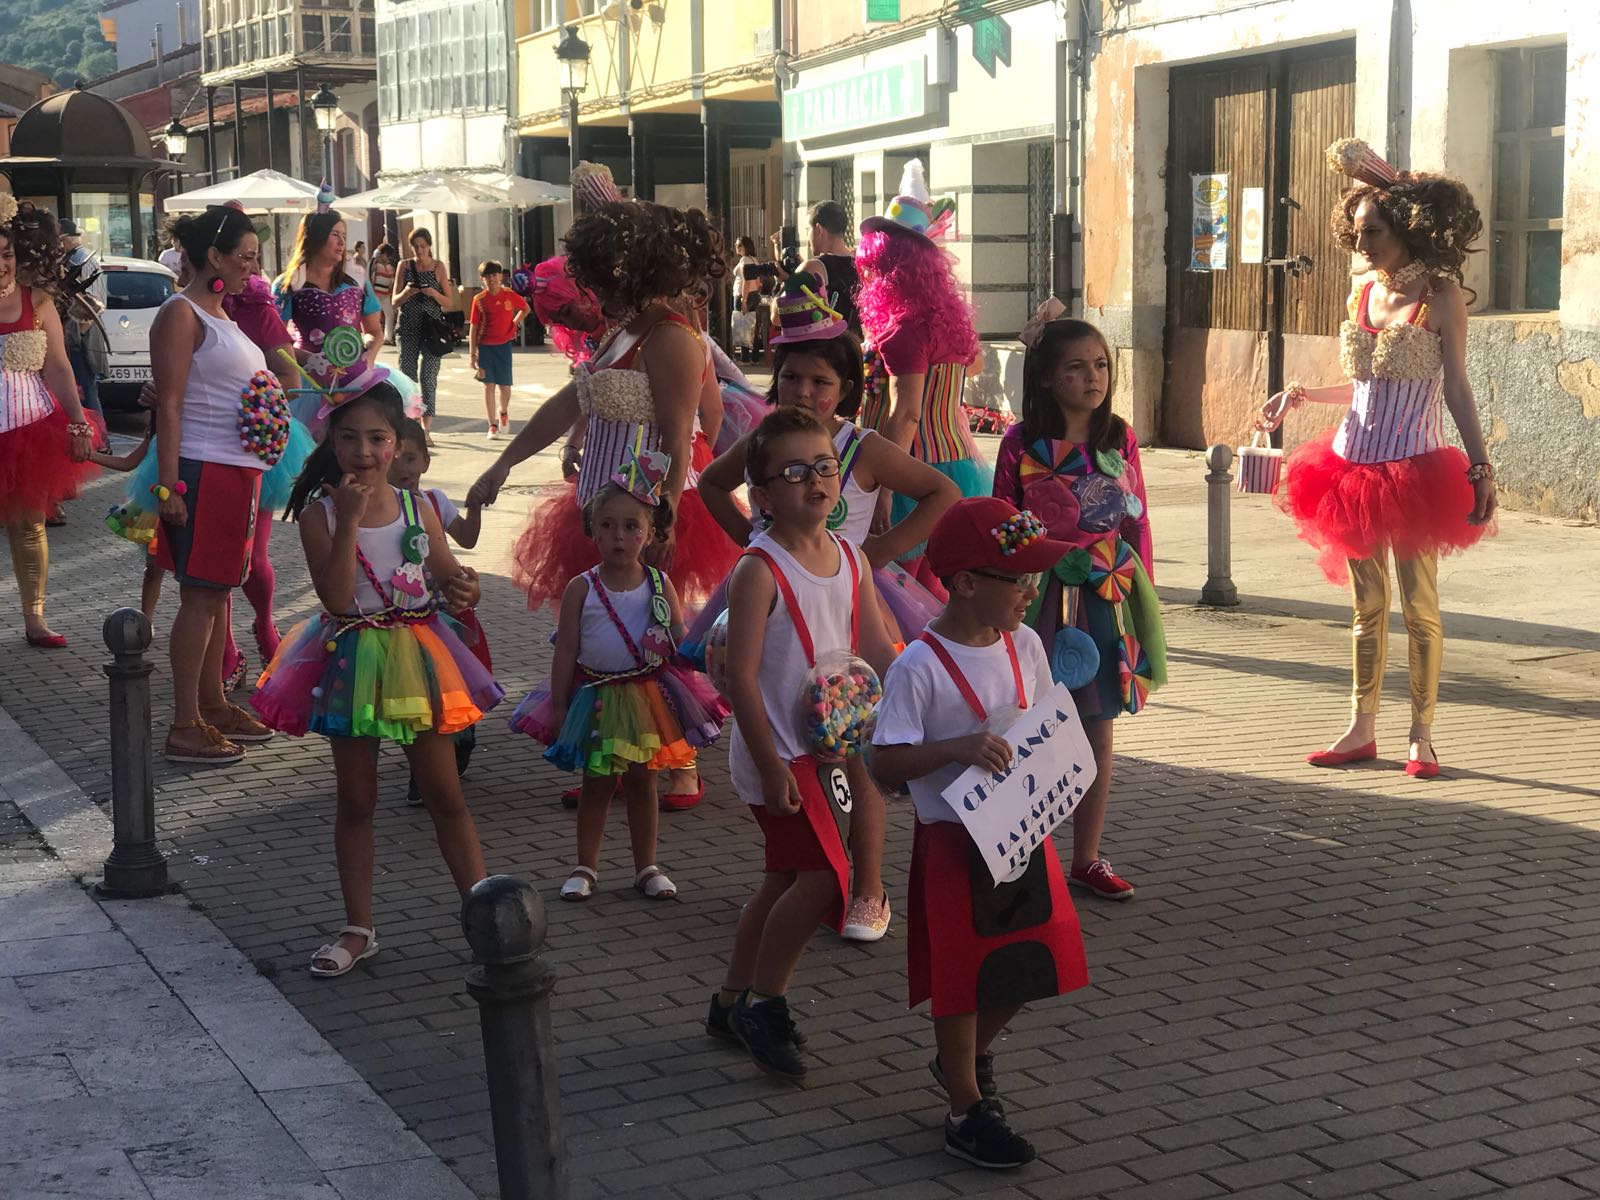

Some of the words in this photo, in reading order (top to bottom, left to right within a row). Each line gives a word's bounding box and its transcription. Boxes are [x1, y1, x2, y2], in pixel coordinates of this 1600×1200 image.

[804, 71, 892, 129] FARMACIA
[110, 368, 130, 379] 469
[963, 709, 1069, 812] CHARANGA
[1022, 773, 1040, 798] 2
[996, 831, 1020, 857] LA
[1019, 763, 1083, 834] FÁBRICA
[1009, 841, 1030, 870] DE
[1029, 784, 1084, 847] DULCES
